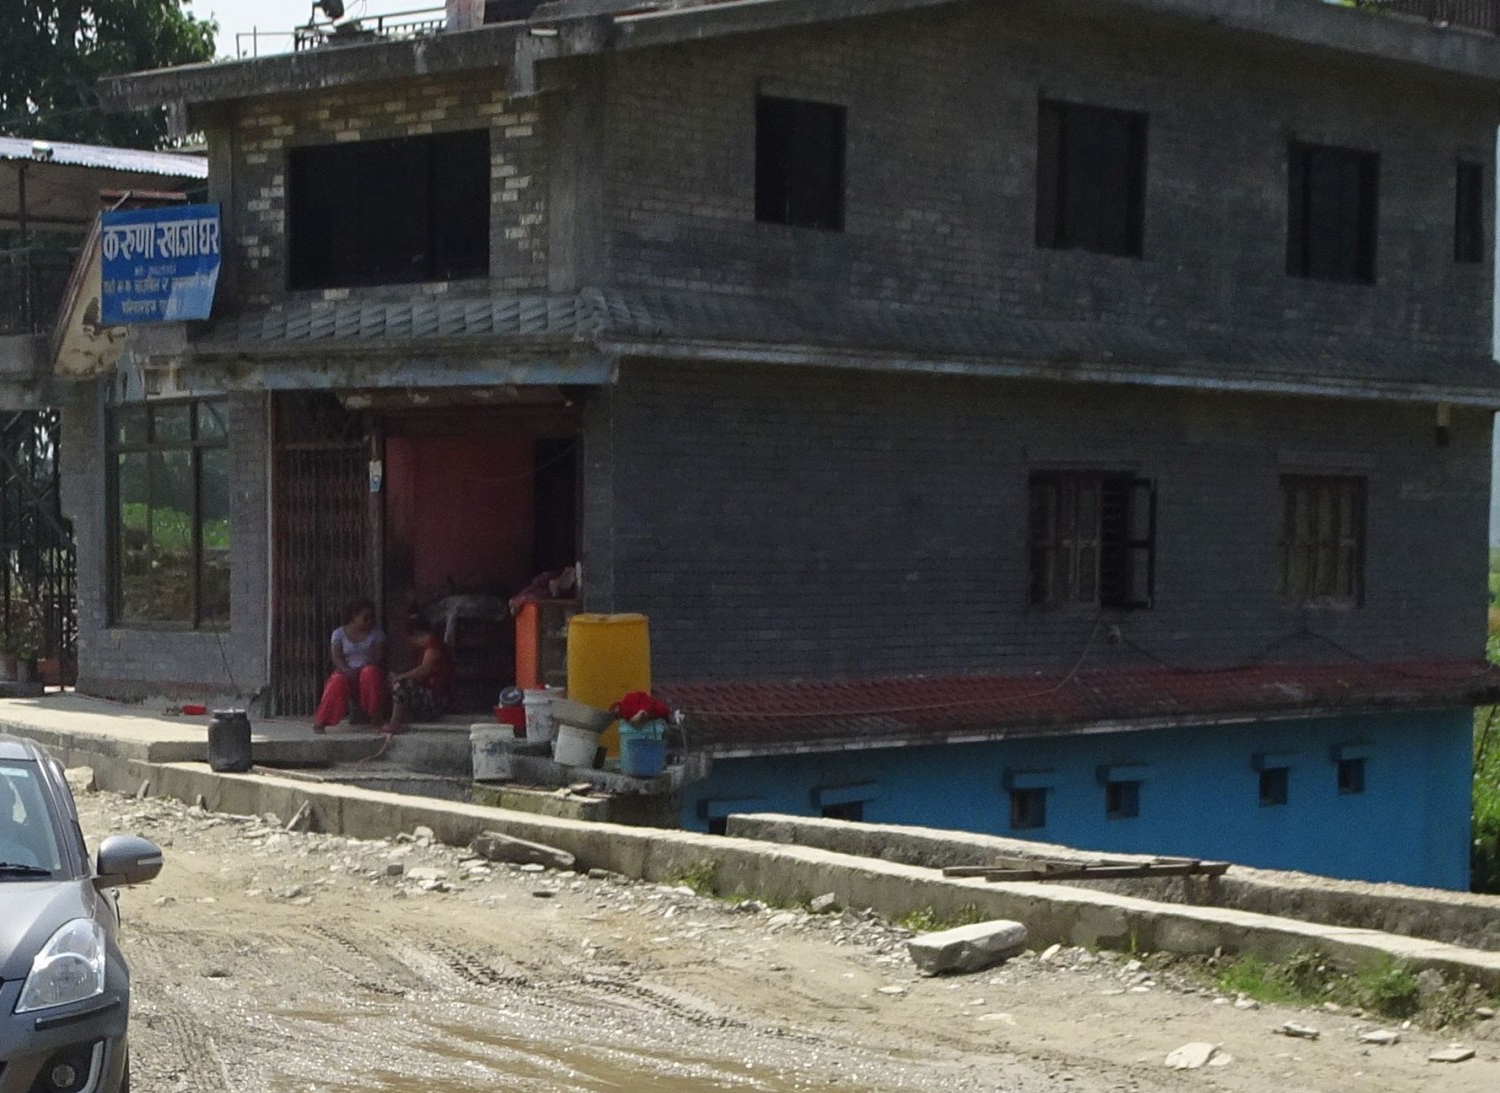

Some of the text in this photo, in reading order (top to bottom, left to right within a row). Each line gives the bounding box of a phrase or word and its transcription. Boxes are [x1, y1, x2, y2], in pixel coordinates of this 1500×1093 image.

[103, 218, 219, 260] करुणा खाजा घर
